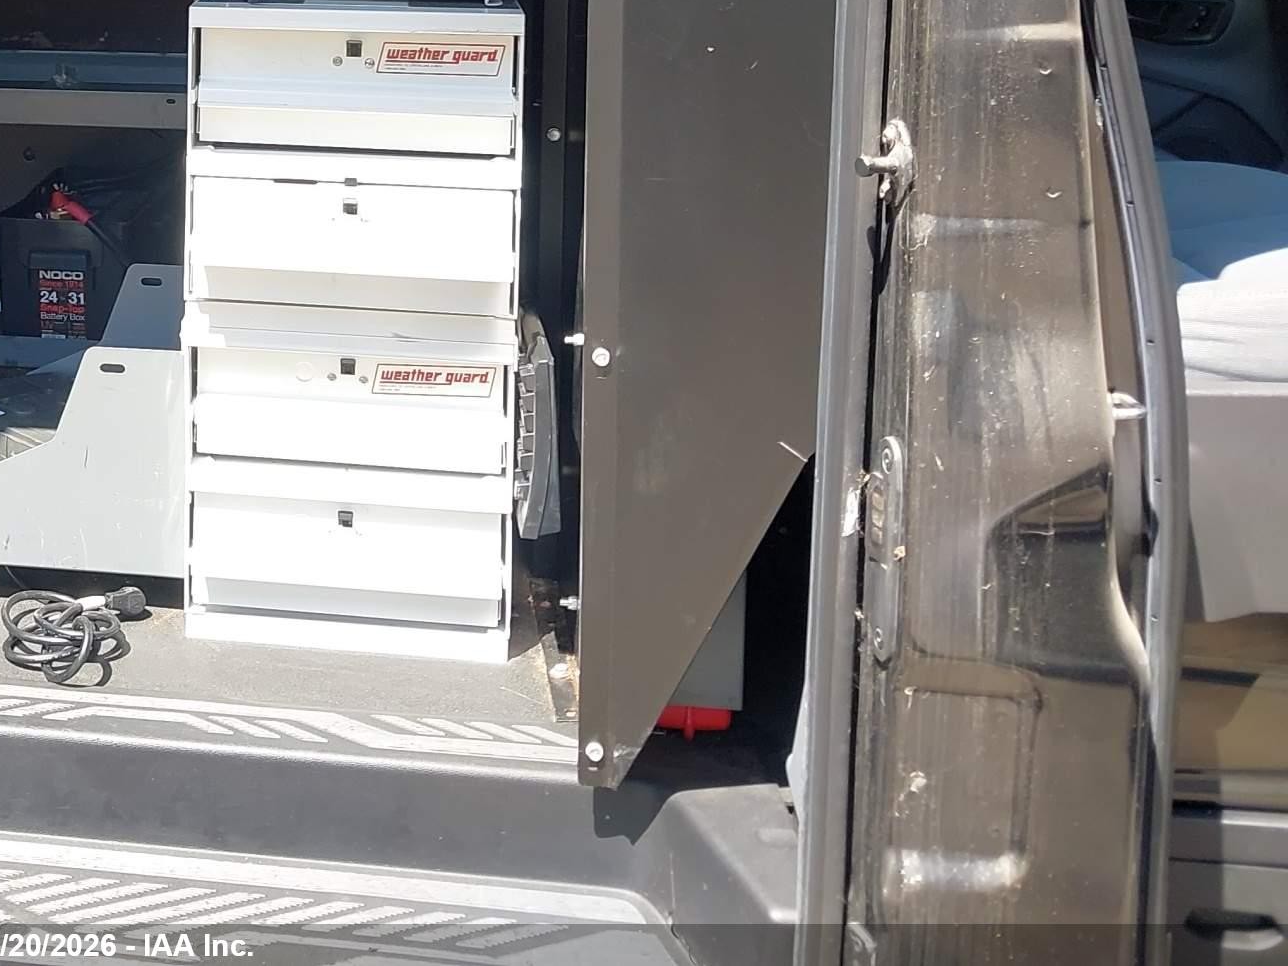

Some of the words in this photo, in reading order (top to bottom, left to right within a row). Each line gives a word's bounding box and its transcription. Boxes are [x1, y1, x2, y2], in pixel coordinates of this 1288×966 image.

[386, 47, 450, 61] weather
[452, 49, 498, 64] guard
[39, 269, 84, 280] NOCO
[39, 290, 58, 303] 24
[67, 292, 85, 305] 31
[40, 311, 68, 321] Battery
[69, 313, 85, 321] Box
[381, 368, 443, 382] weather
[445, 370, 489, 385] guard
